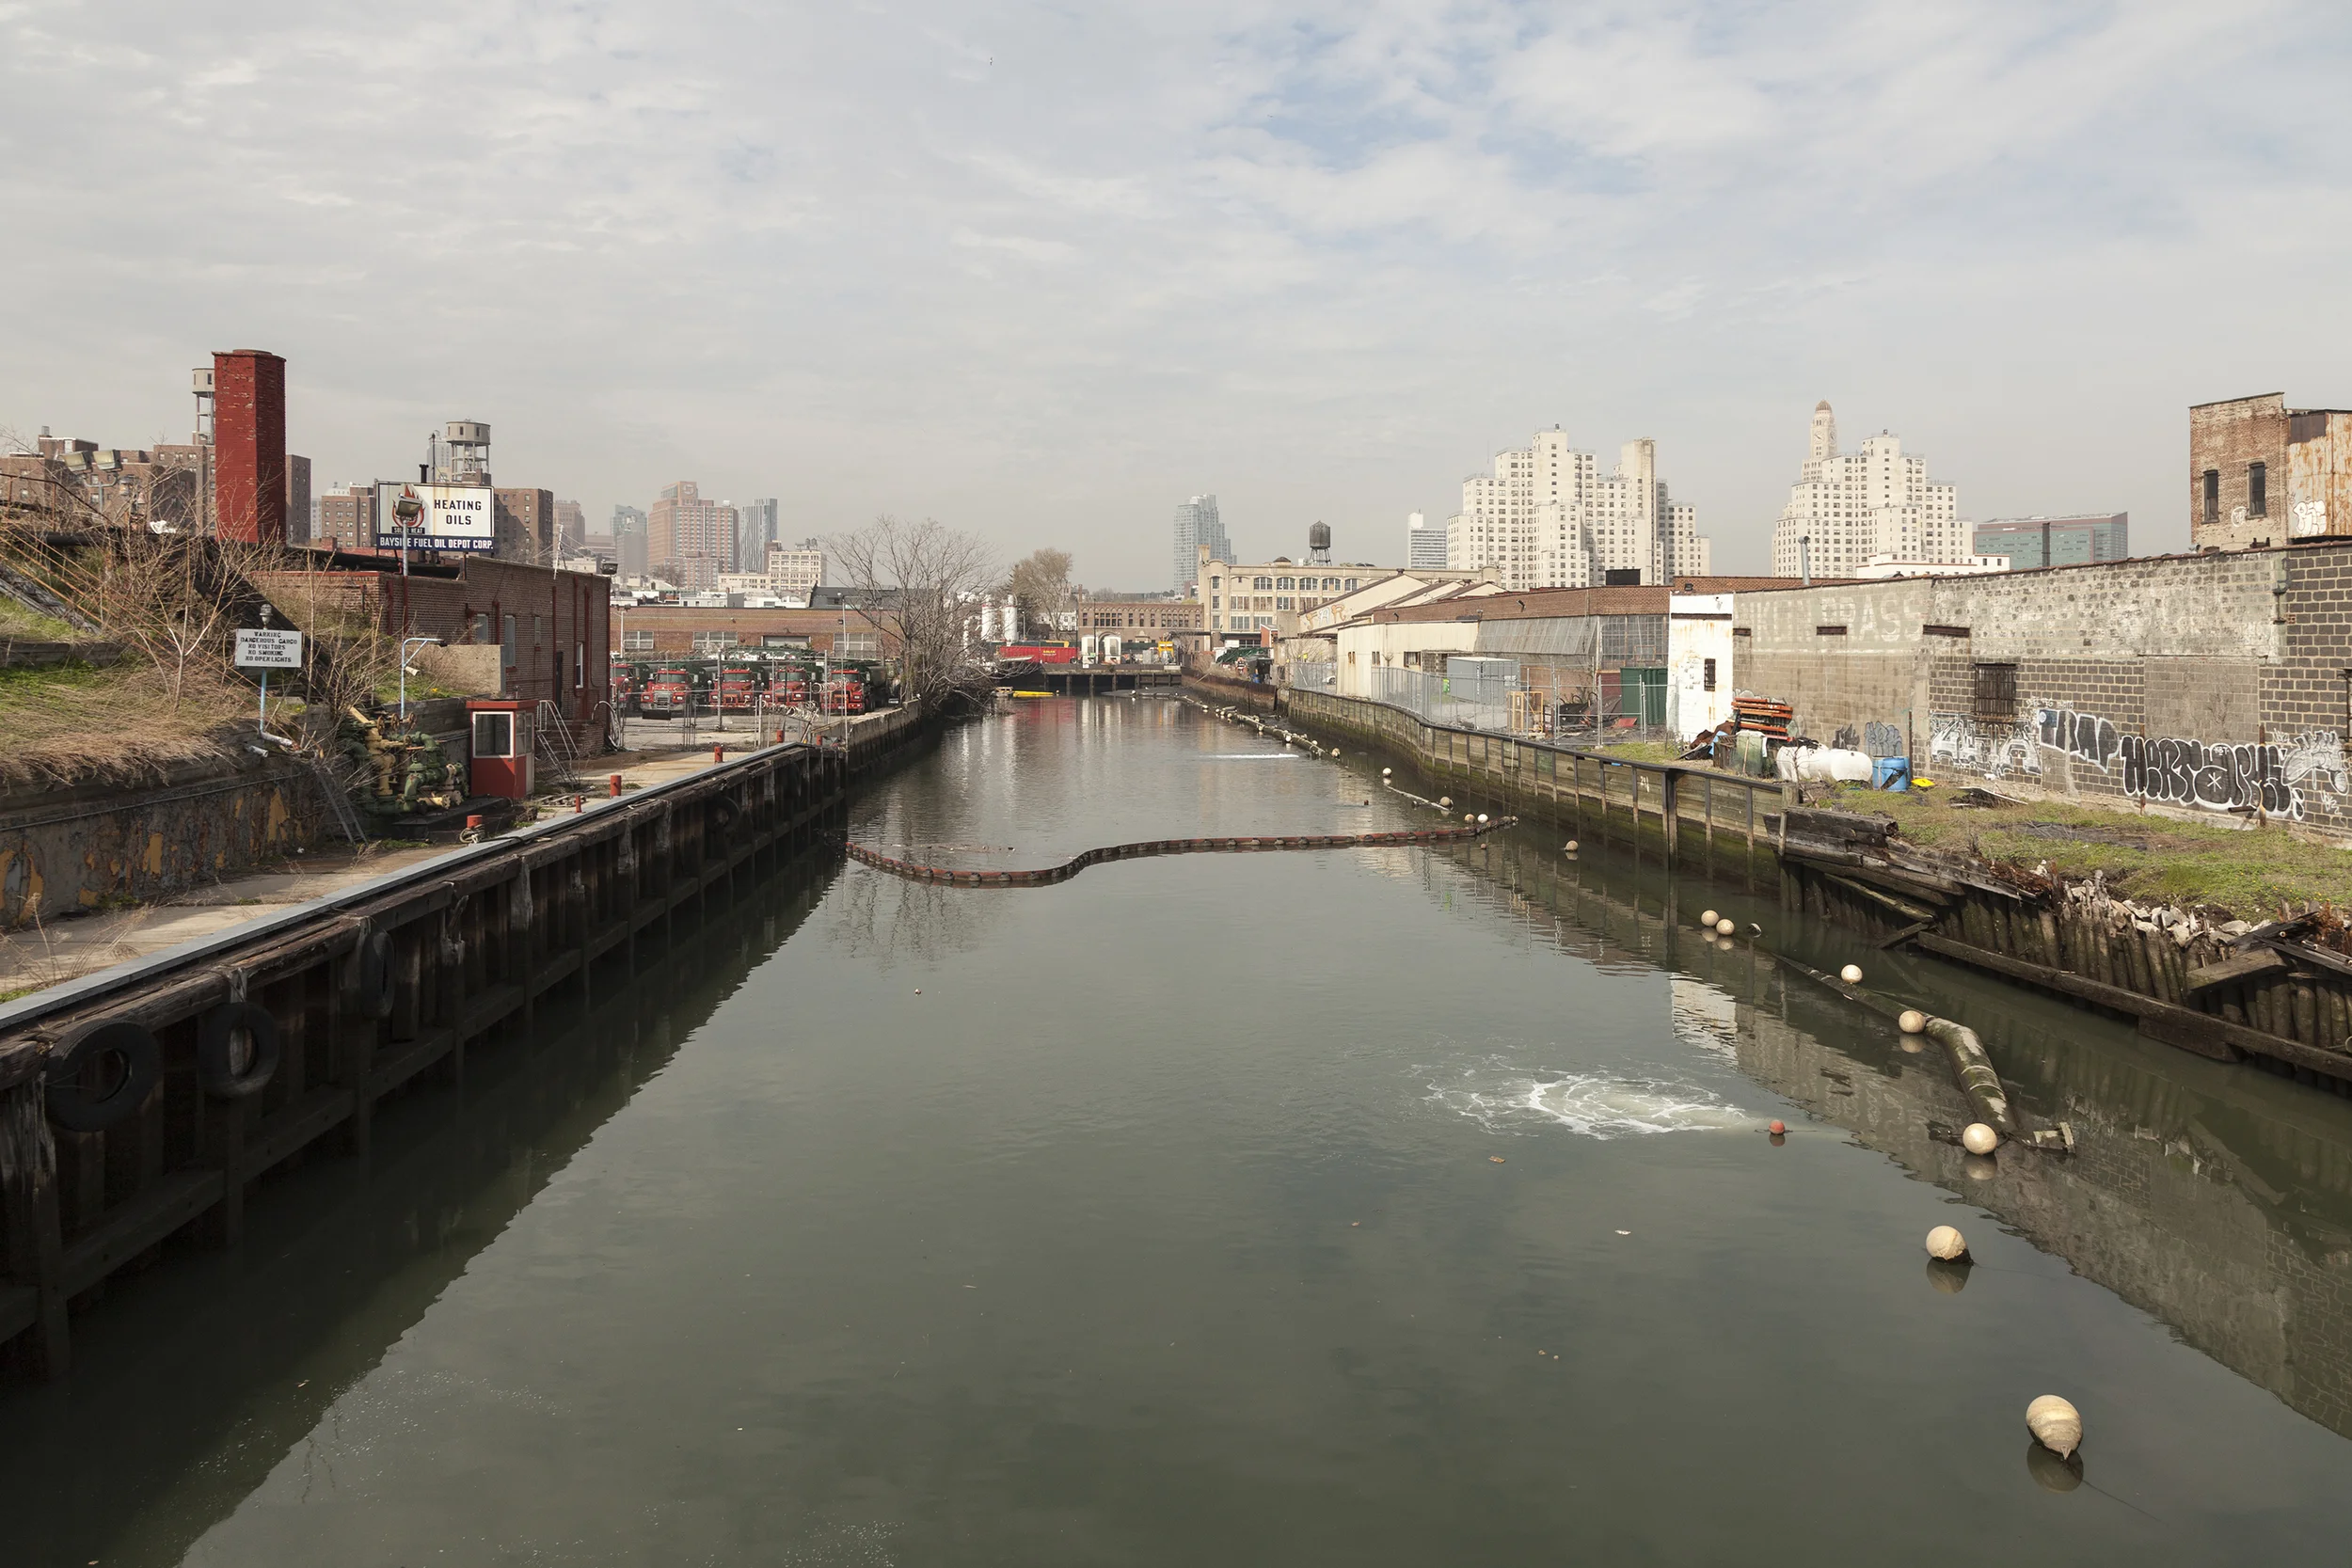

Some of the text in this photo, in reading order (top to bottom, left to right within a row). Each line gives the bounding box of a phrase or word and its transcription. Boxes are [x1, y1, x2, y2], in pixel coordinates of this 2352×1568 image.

[435, 499, 482, 511] HEATING
[446, 515, 471, 525] OILS
[380, 536, 494, 549] BAYSIE FUEL OIL DEPOT CORP.
